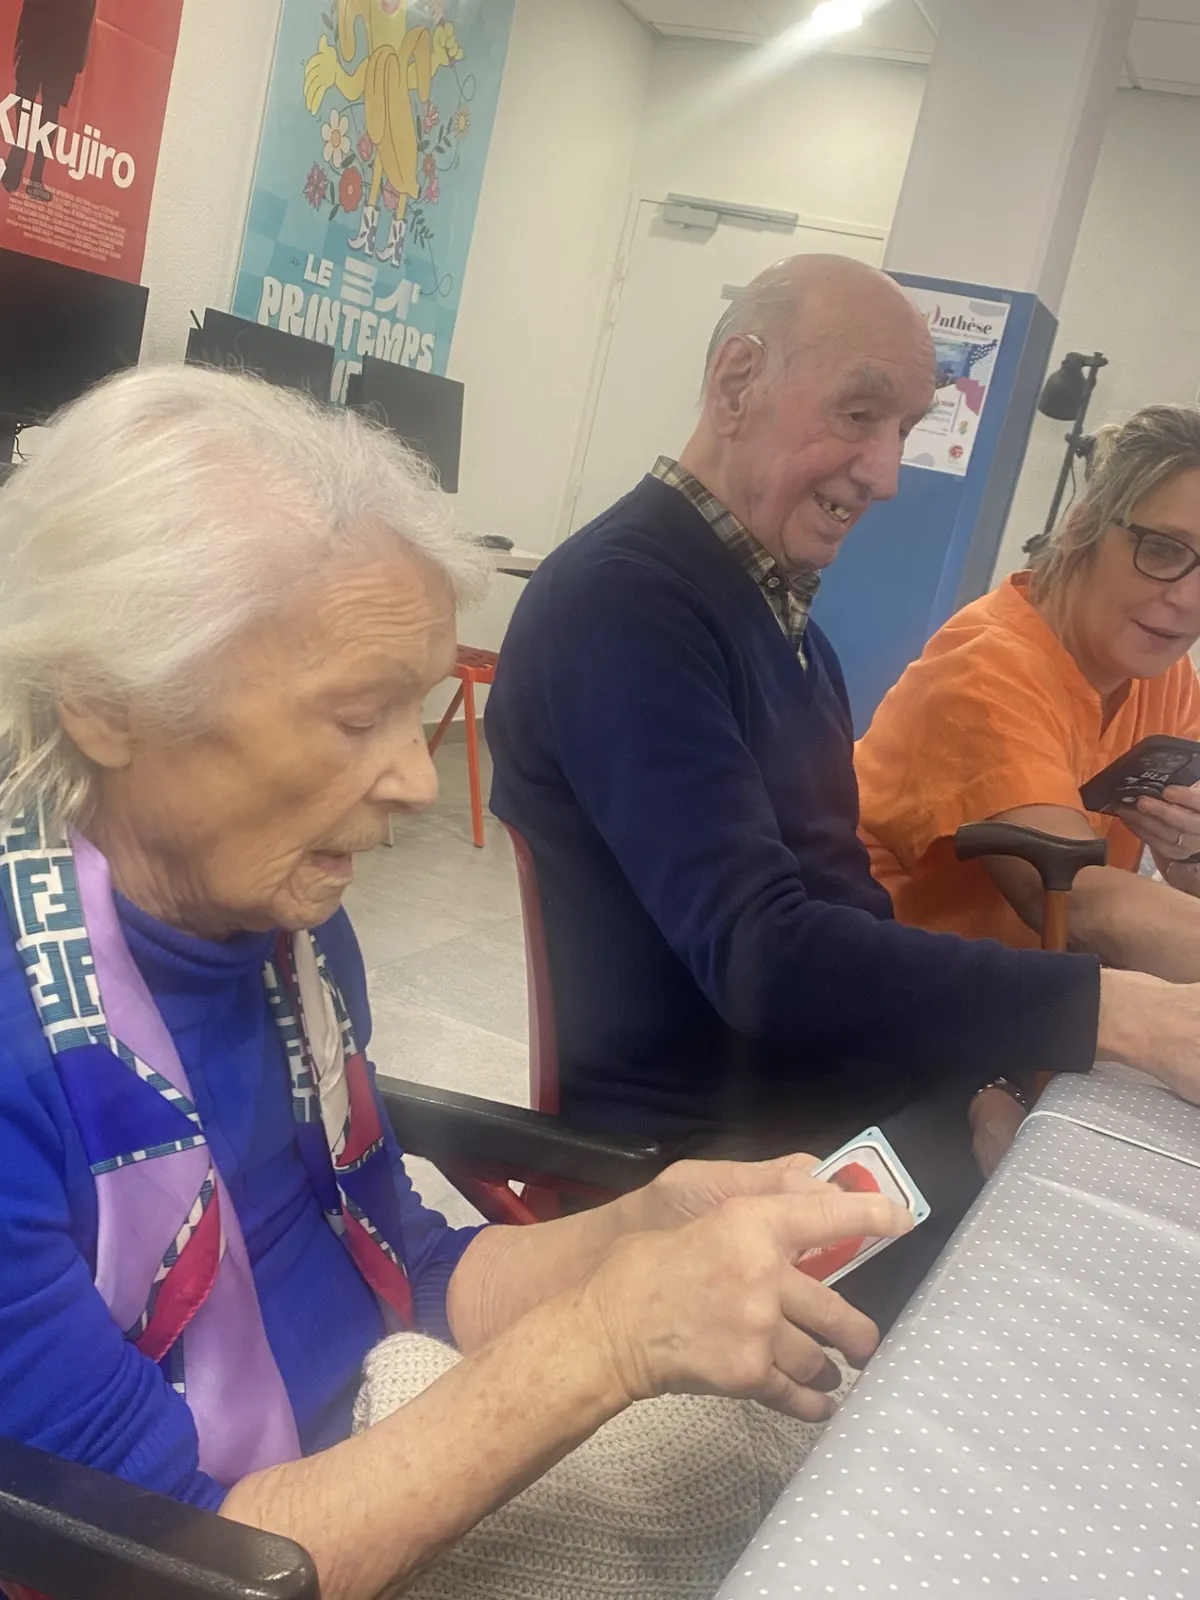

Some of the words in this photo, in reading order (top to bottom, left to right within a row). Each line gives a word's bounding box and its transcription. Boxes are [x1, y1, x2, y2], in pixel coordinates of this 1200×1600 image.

[0, 93, 135, 188] Kikujiro
[303, 253, 334, 288] LE
[257, 276, 435, 373] PRINTEMPS
